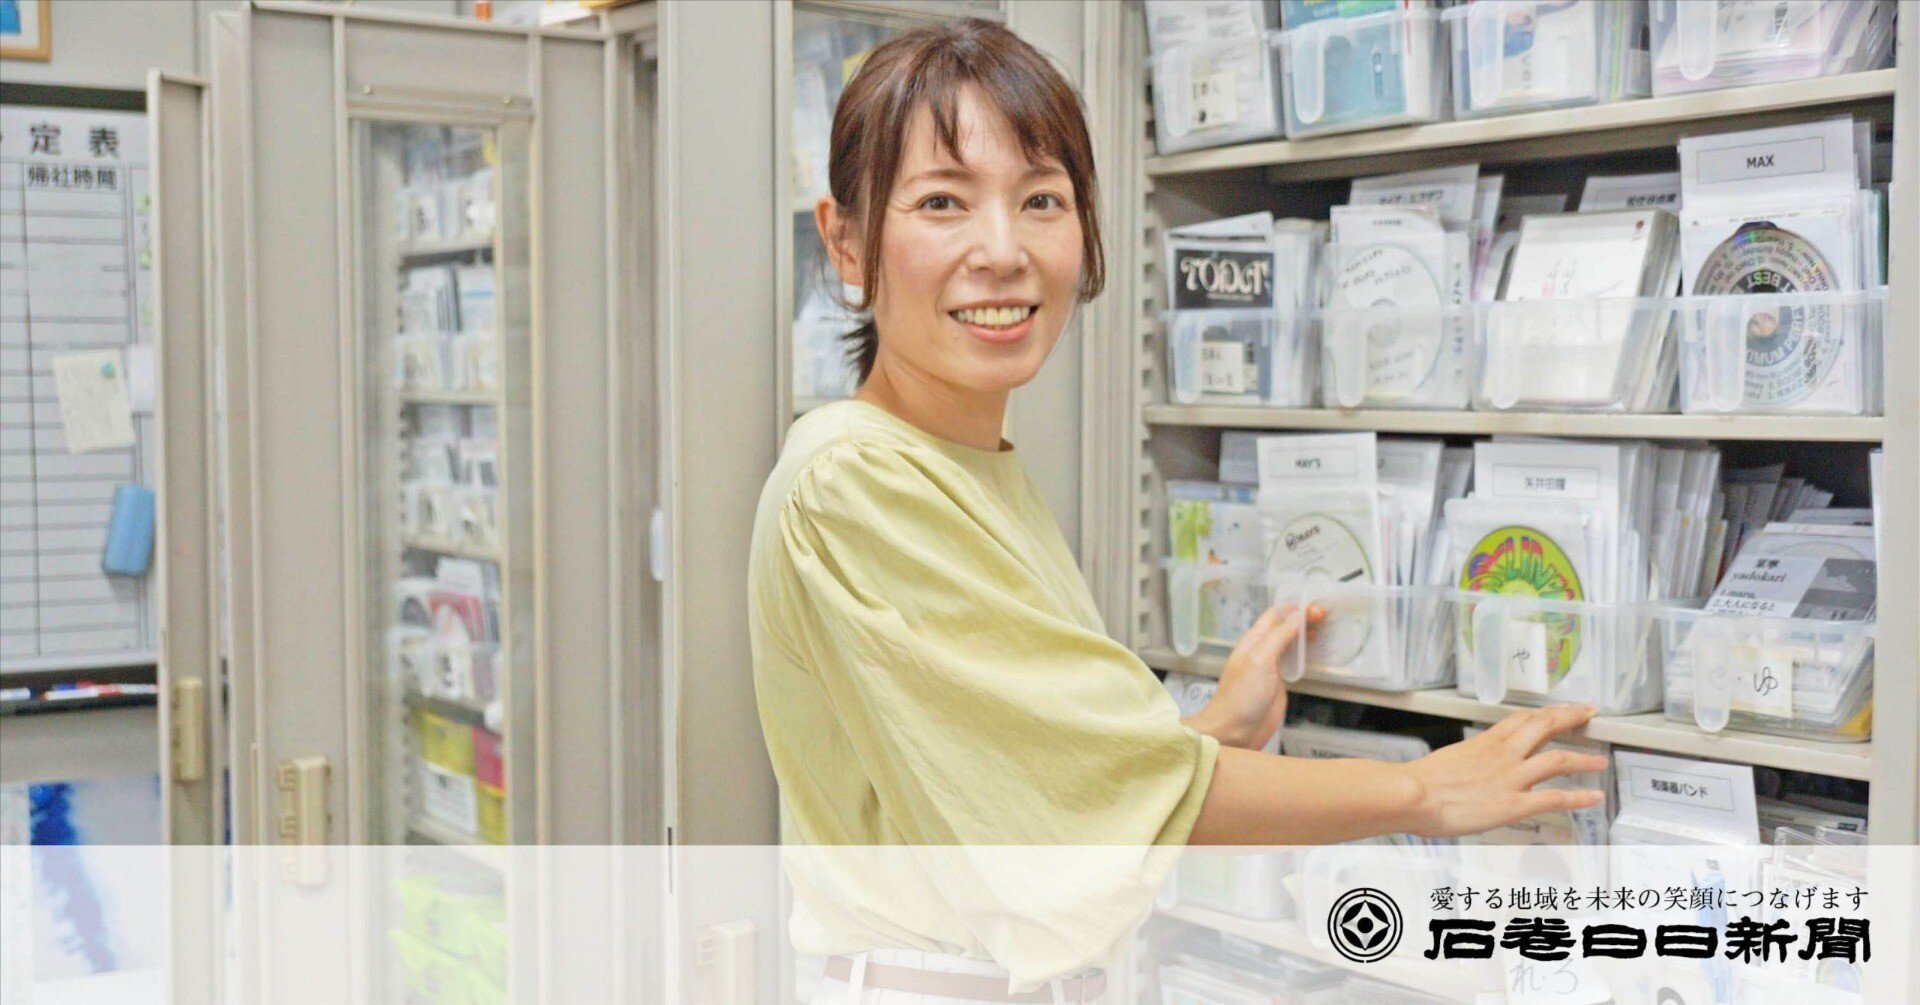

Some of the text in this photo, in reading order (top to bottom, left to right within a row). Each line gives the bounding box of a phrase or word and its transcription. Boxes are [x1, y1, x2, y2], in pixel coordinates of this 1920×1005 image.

[0, 122, 120, 158] 定表
[1746, 154, 1775, 169] MAX
[1512, 649, 1531, 674] や
[1650, 778, 1709, 799] 和楽器バンド
